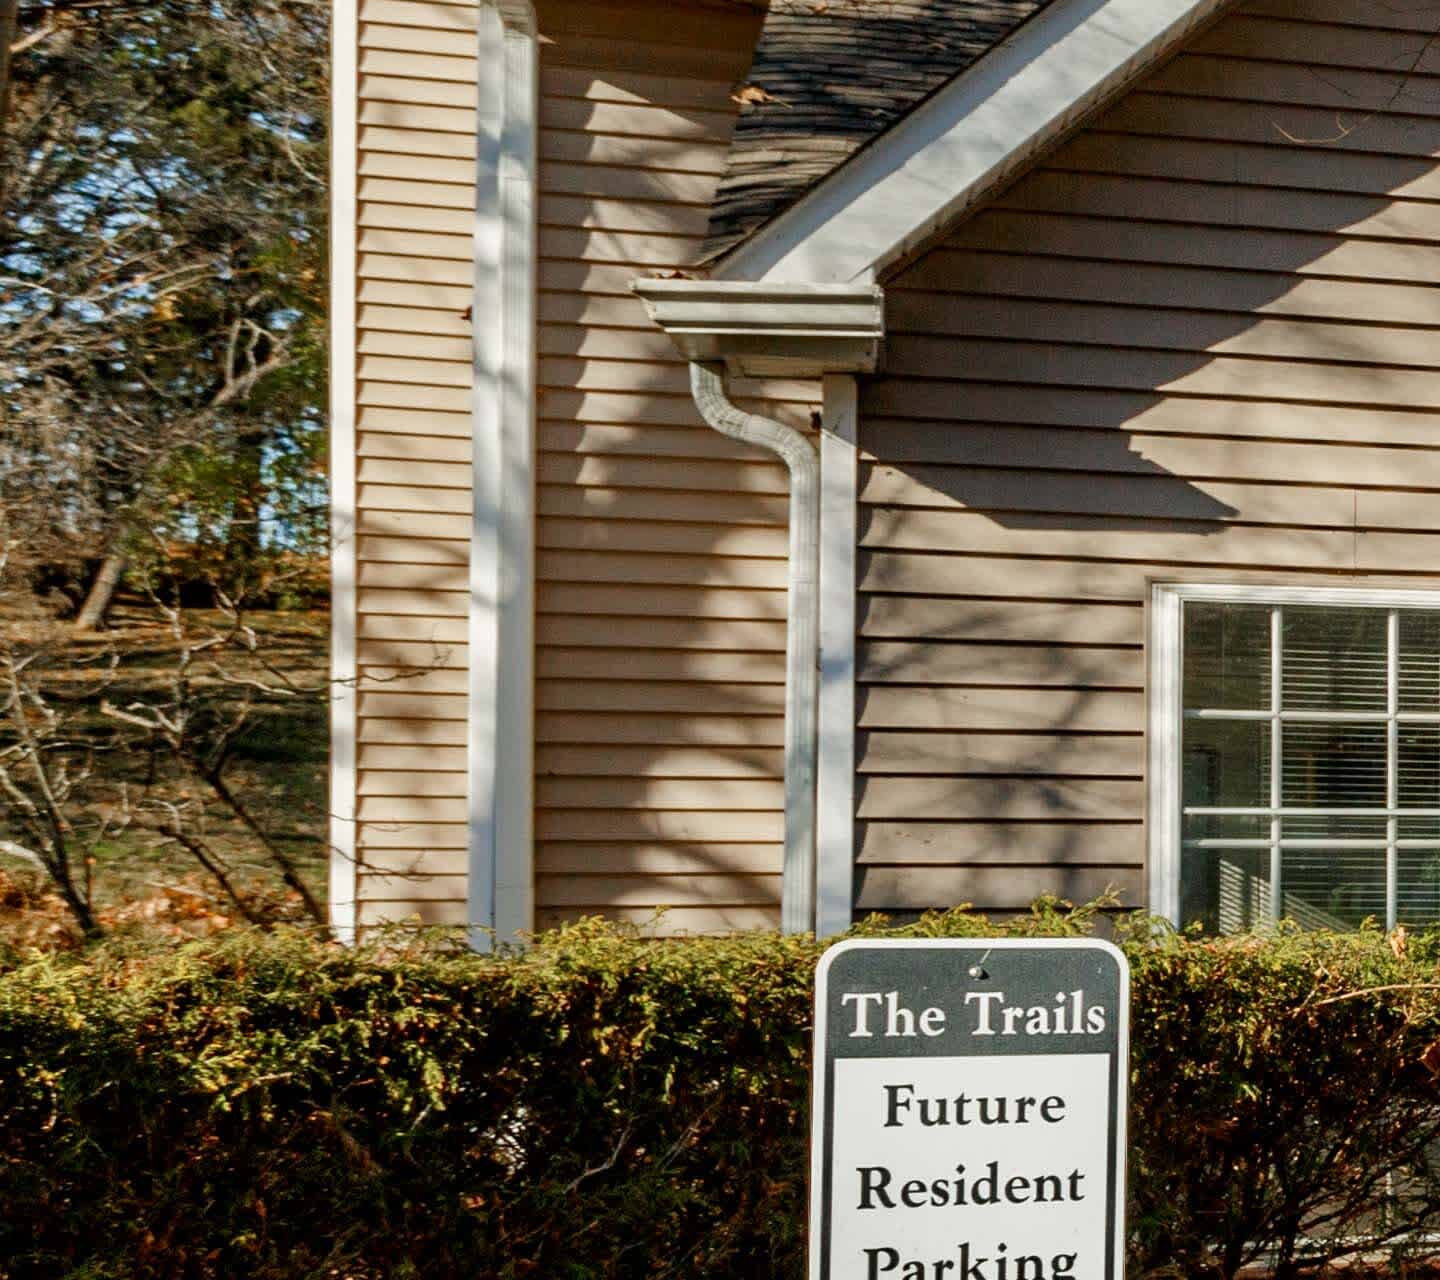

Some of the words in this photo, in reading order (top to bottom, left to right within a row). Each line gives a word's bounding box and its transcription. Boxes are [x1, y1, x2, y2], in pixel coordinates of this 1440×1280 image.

[841, 991, 946, 1039] The
[964, 990, 1106, 1037] Trails
[883, 1084, 1066, 1128] Future
[856, 1161, 1086, 1210] Resident
